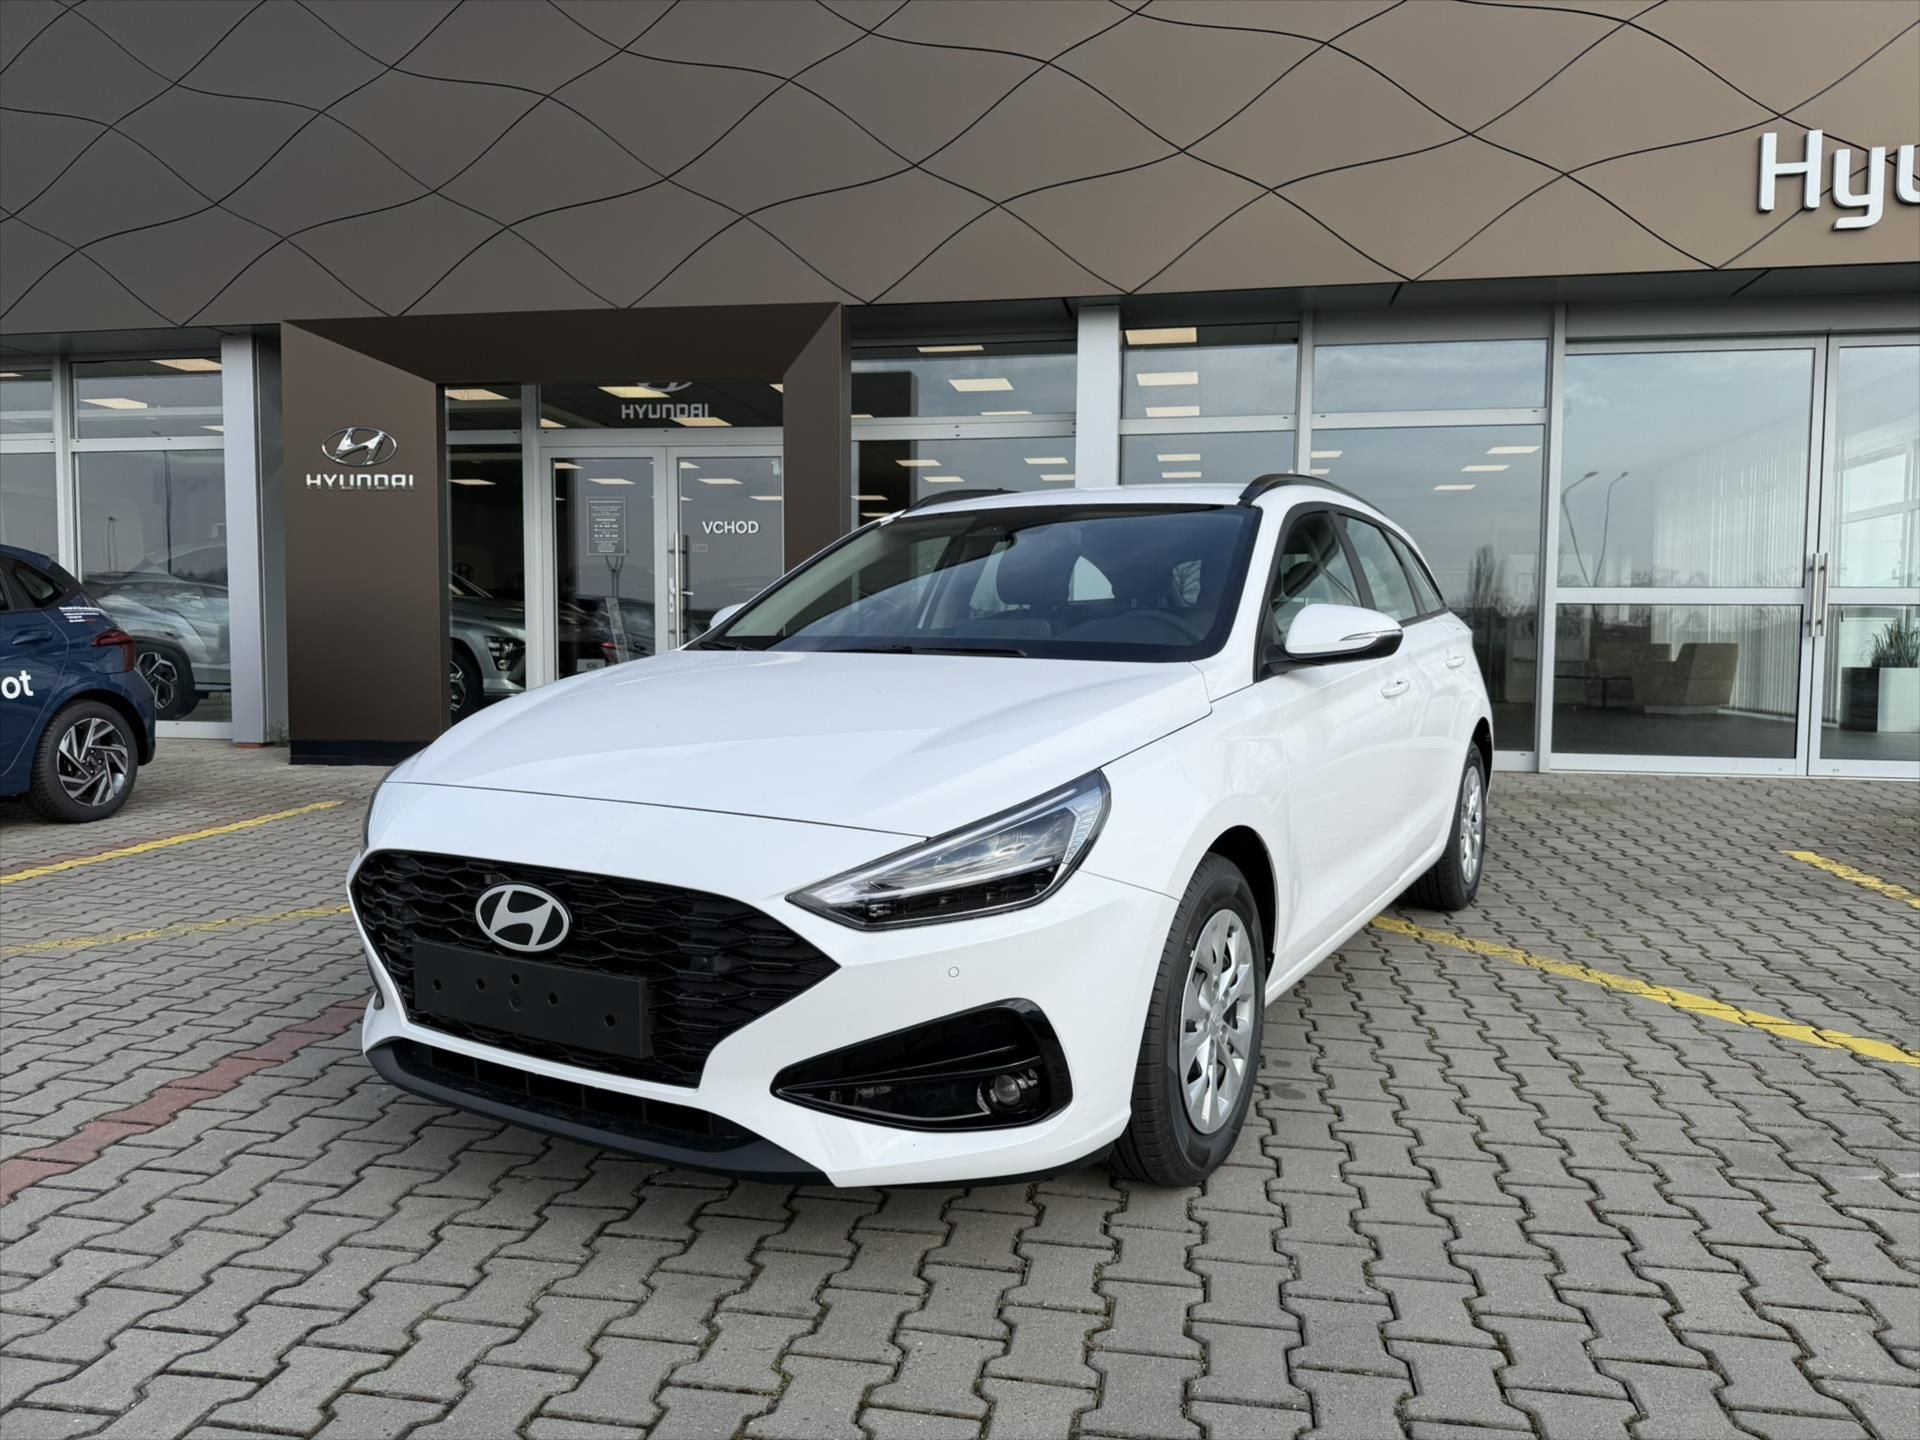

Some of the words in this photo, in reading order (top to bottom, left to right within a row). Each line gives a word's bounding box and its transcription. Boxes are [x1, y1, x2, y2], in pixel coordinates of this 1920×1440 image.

[621, 404, 709, 419] HYUNDAI
[305, 473, 414, 490] HYUNDAI
[702, 521, 760, 535] VCHOD
[1, 670, 34, 699] ot
